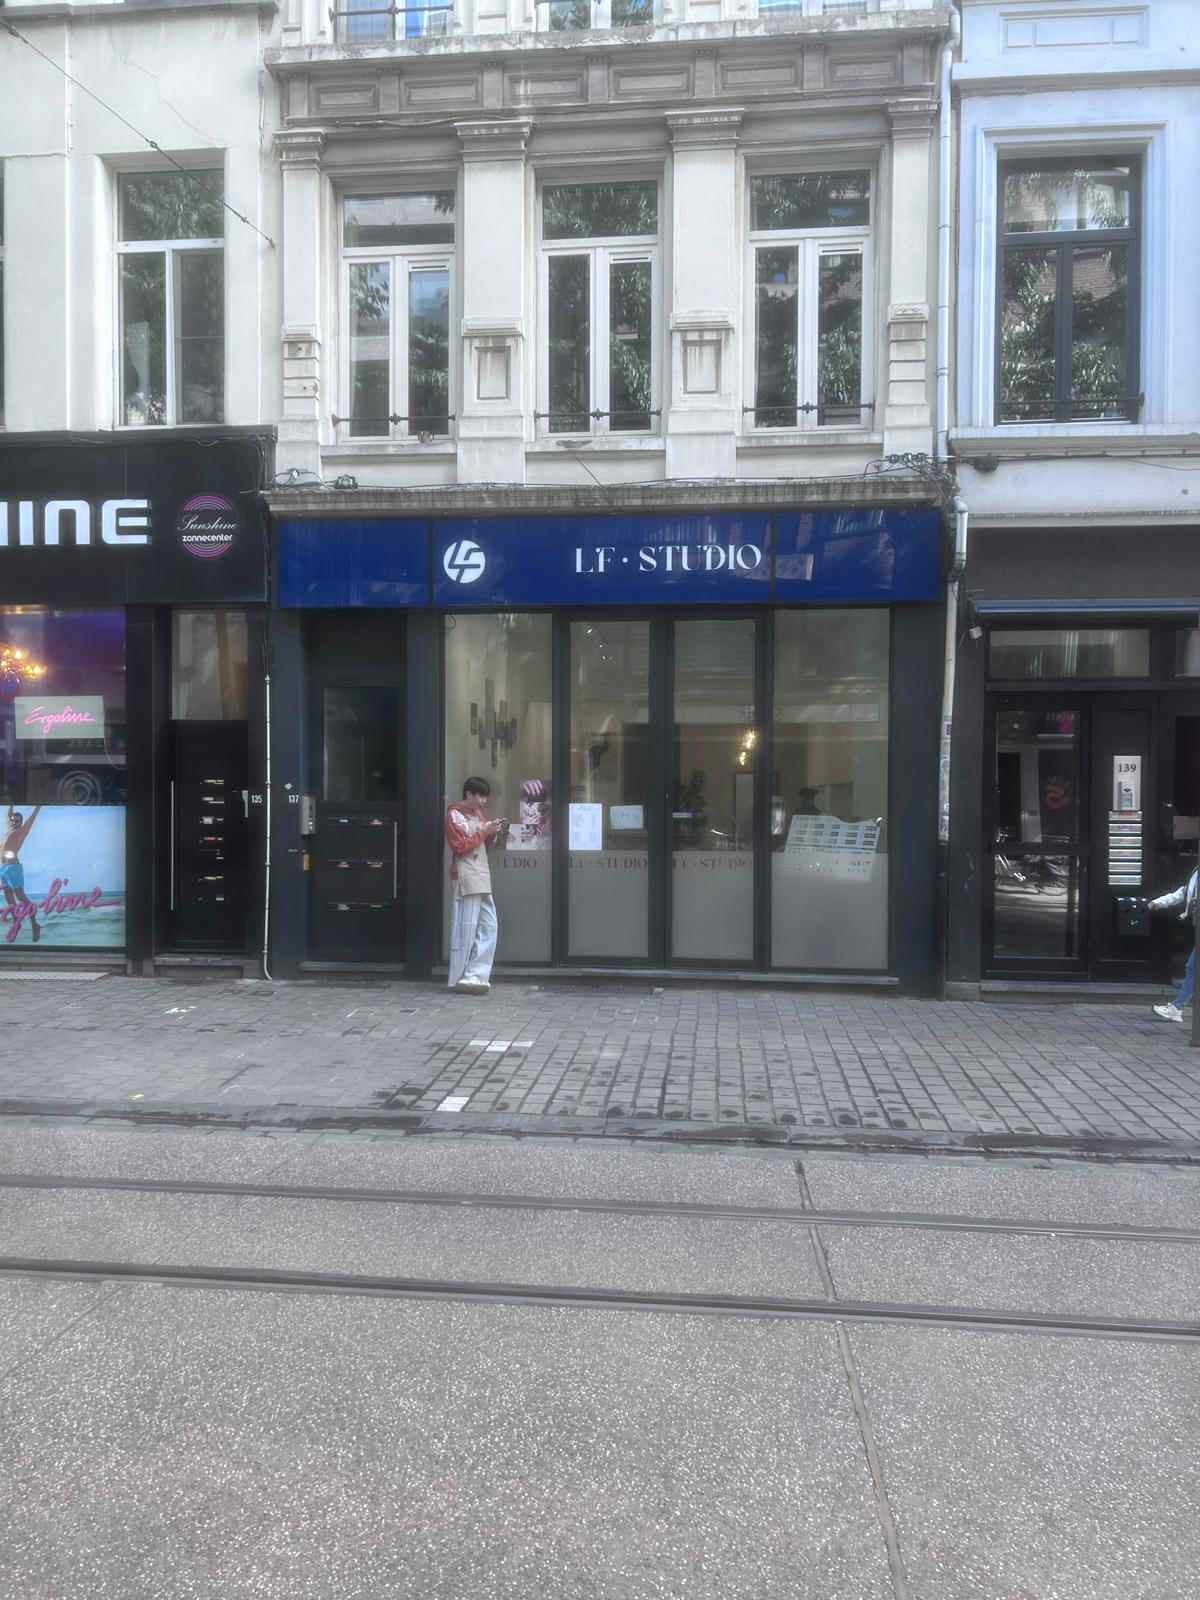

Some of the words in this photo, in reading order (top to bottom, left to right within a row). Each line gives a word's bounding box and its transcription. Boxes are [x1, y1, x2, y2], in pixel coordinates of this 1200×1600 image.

[0, 499, 150, 546] INE
[177, 514, 238, 531] Sunshine
[182, 533, 233, 543] zonnecenter
[574, 546, 616, 574] LF
[638, 543, 763, 573] STUDIO
[1118, 763, 1137, 773] 139
[288, 794, 299, 804] 137
[0, 877, 123, 943] rgoline
